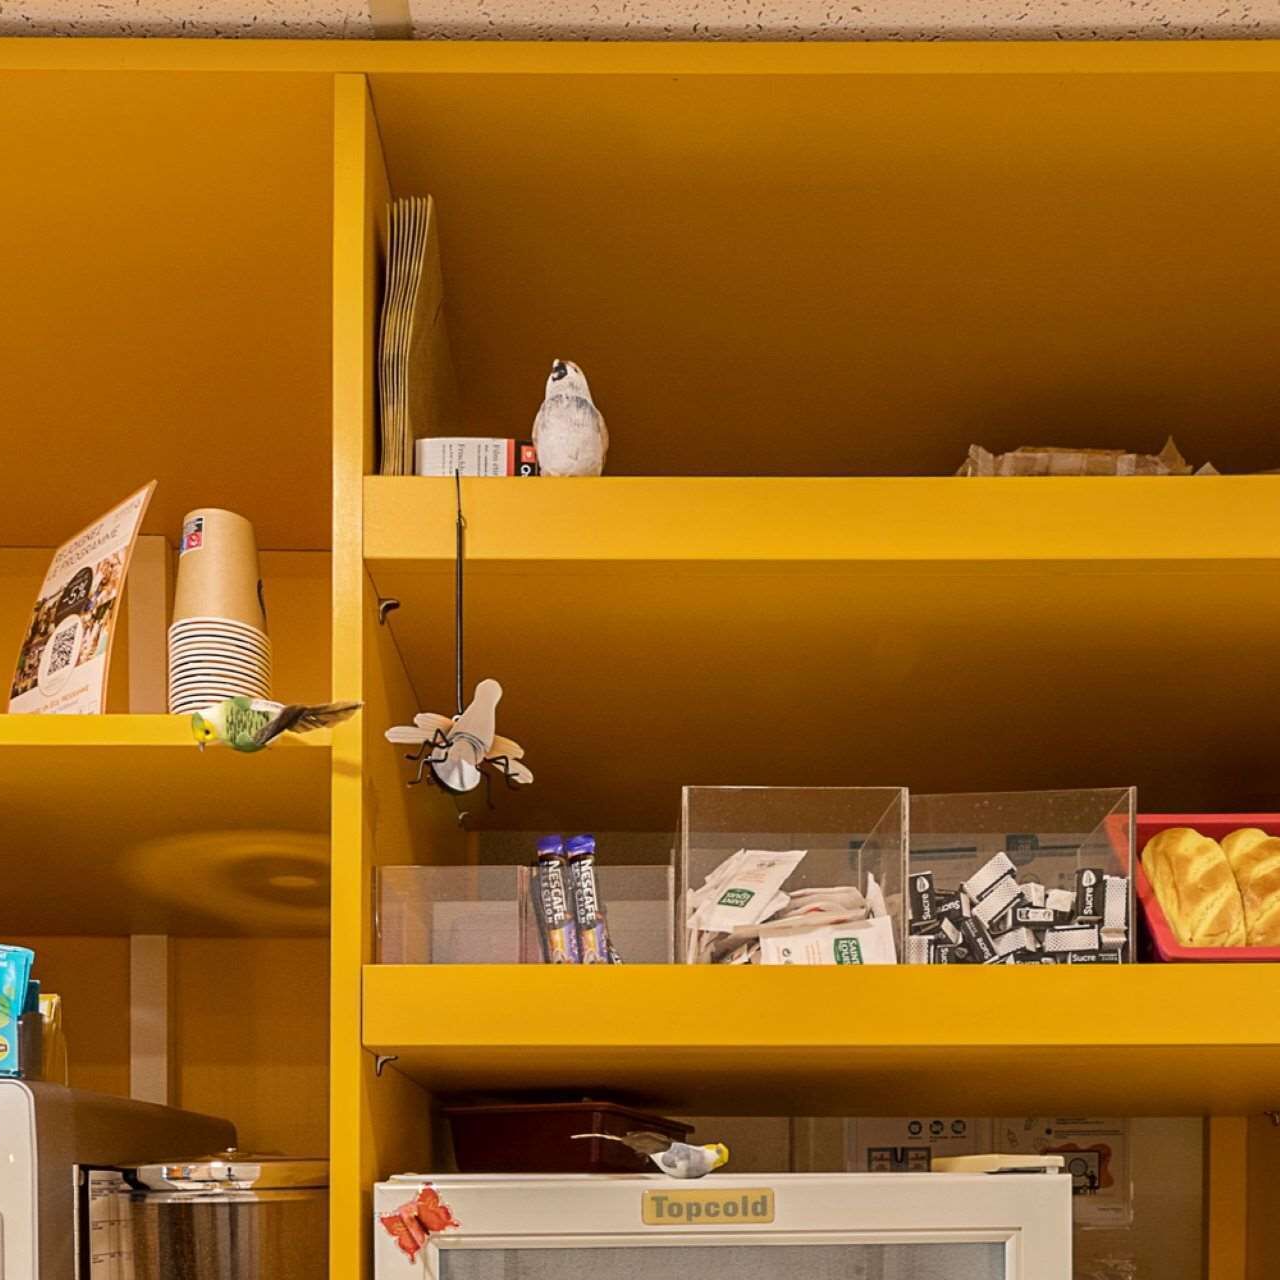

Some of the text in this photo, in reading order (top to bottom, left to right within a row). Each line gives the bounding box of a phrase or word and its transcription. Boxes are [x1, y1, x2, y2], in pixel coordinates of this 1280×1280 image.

[922, 893, 931, 921] Sucre
[1083, 886, 1093, 915] Sucre
[1071, 953, 1096, 962] Sucre
[651, 1194, 768, 1222] Topcold
